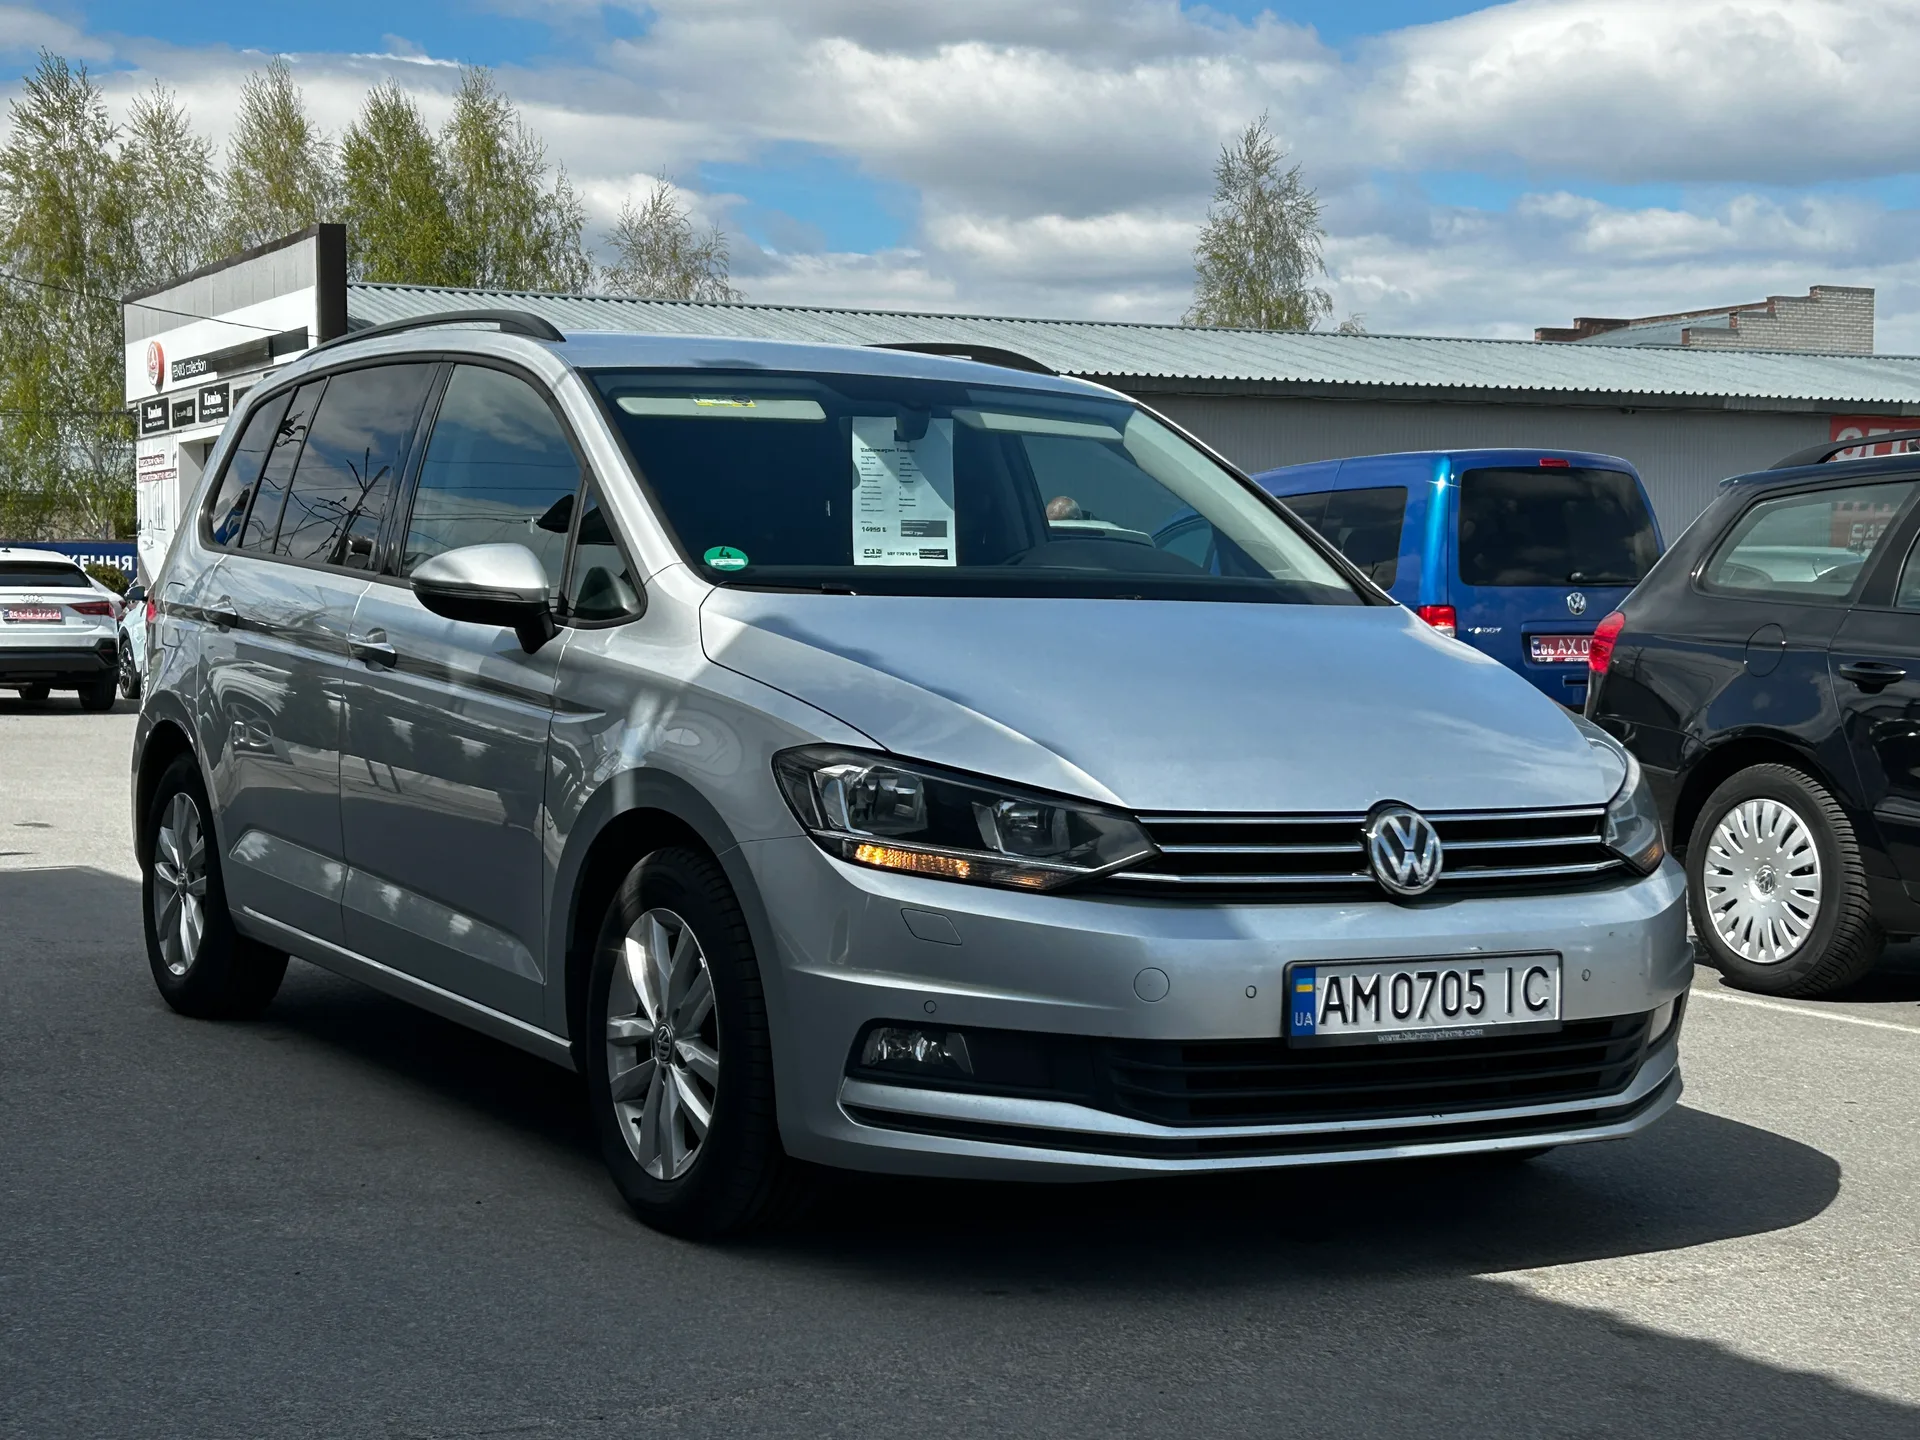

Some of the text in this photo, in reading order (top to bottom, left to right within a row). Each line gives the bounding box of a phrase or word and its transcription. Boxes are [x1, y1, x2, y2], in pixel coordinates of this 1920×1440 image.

[719, 546, 731, 559] 4
[1504, 965, 1550, 1014] IC
[1294, 1011, 1314, 1027] UA
